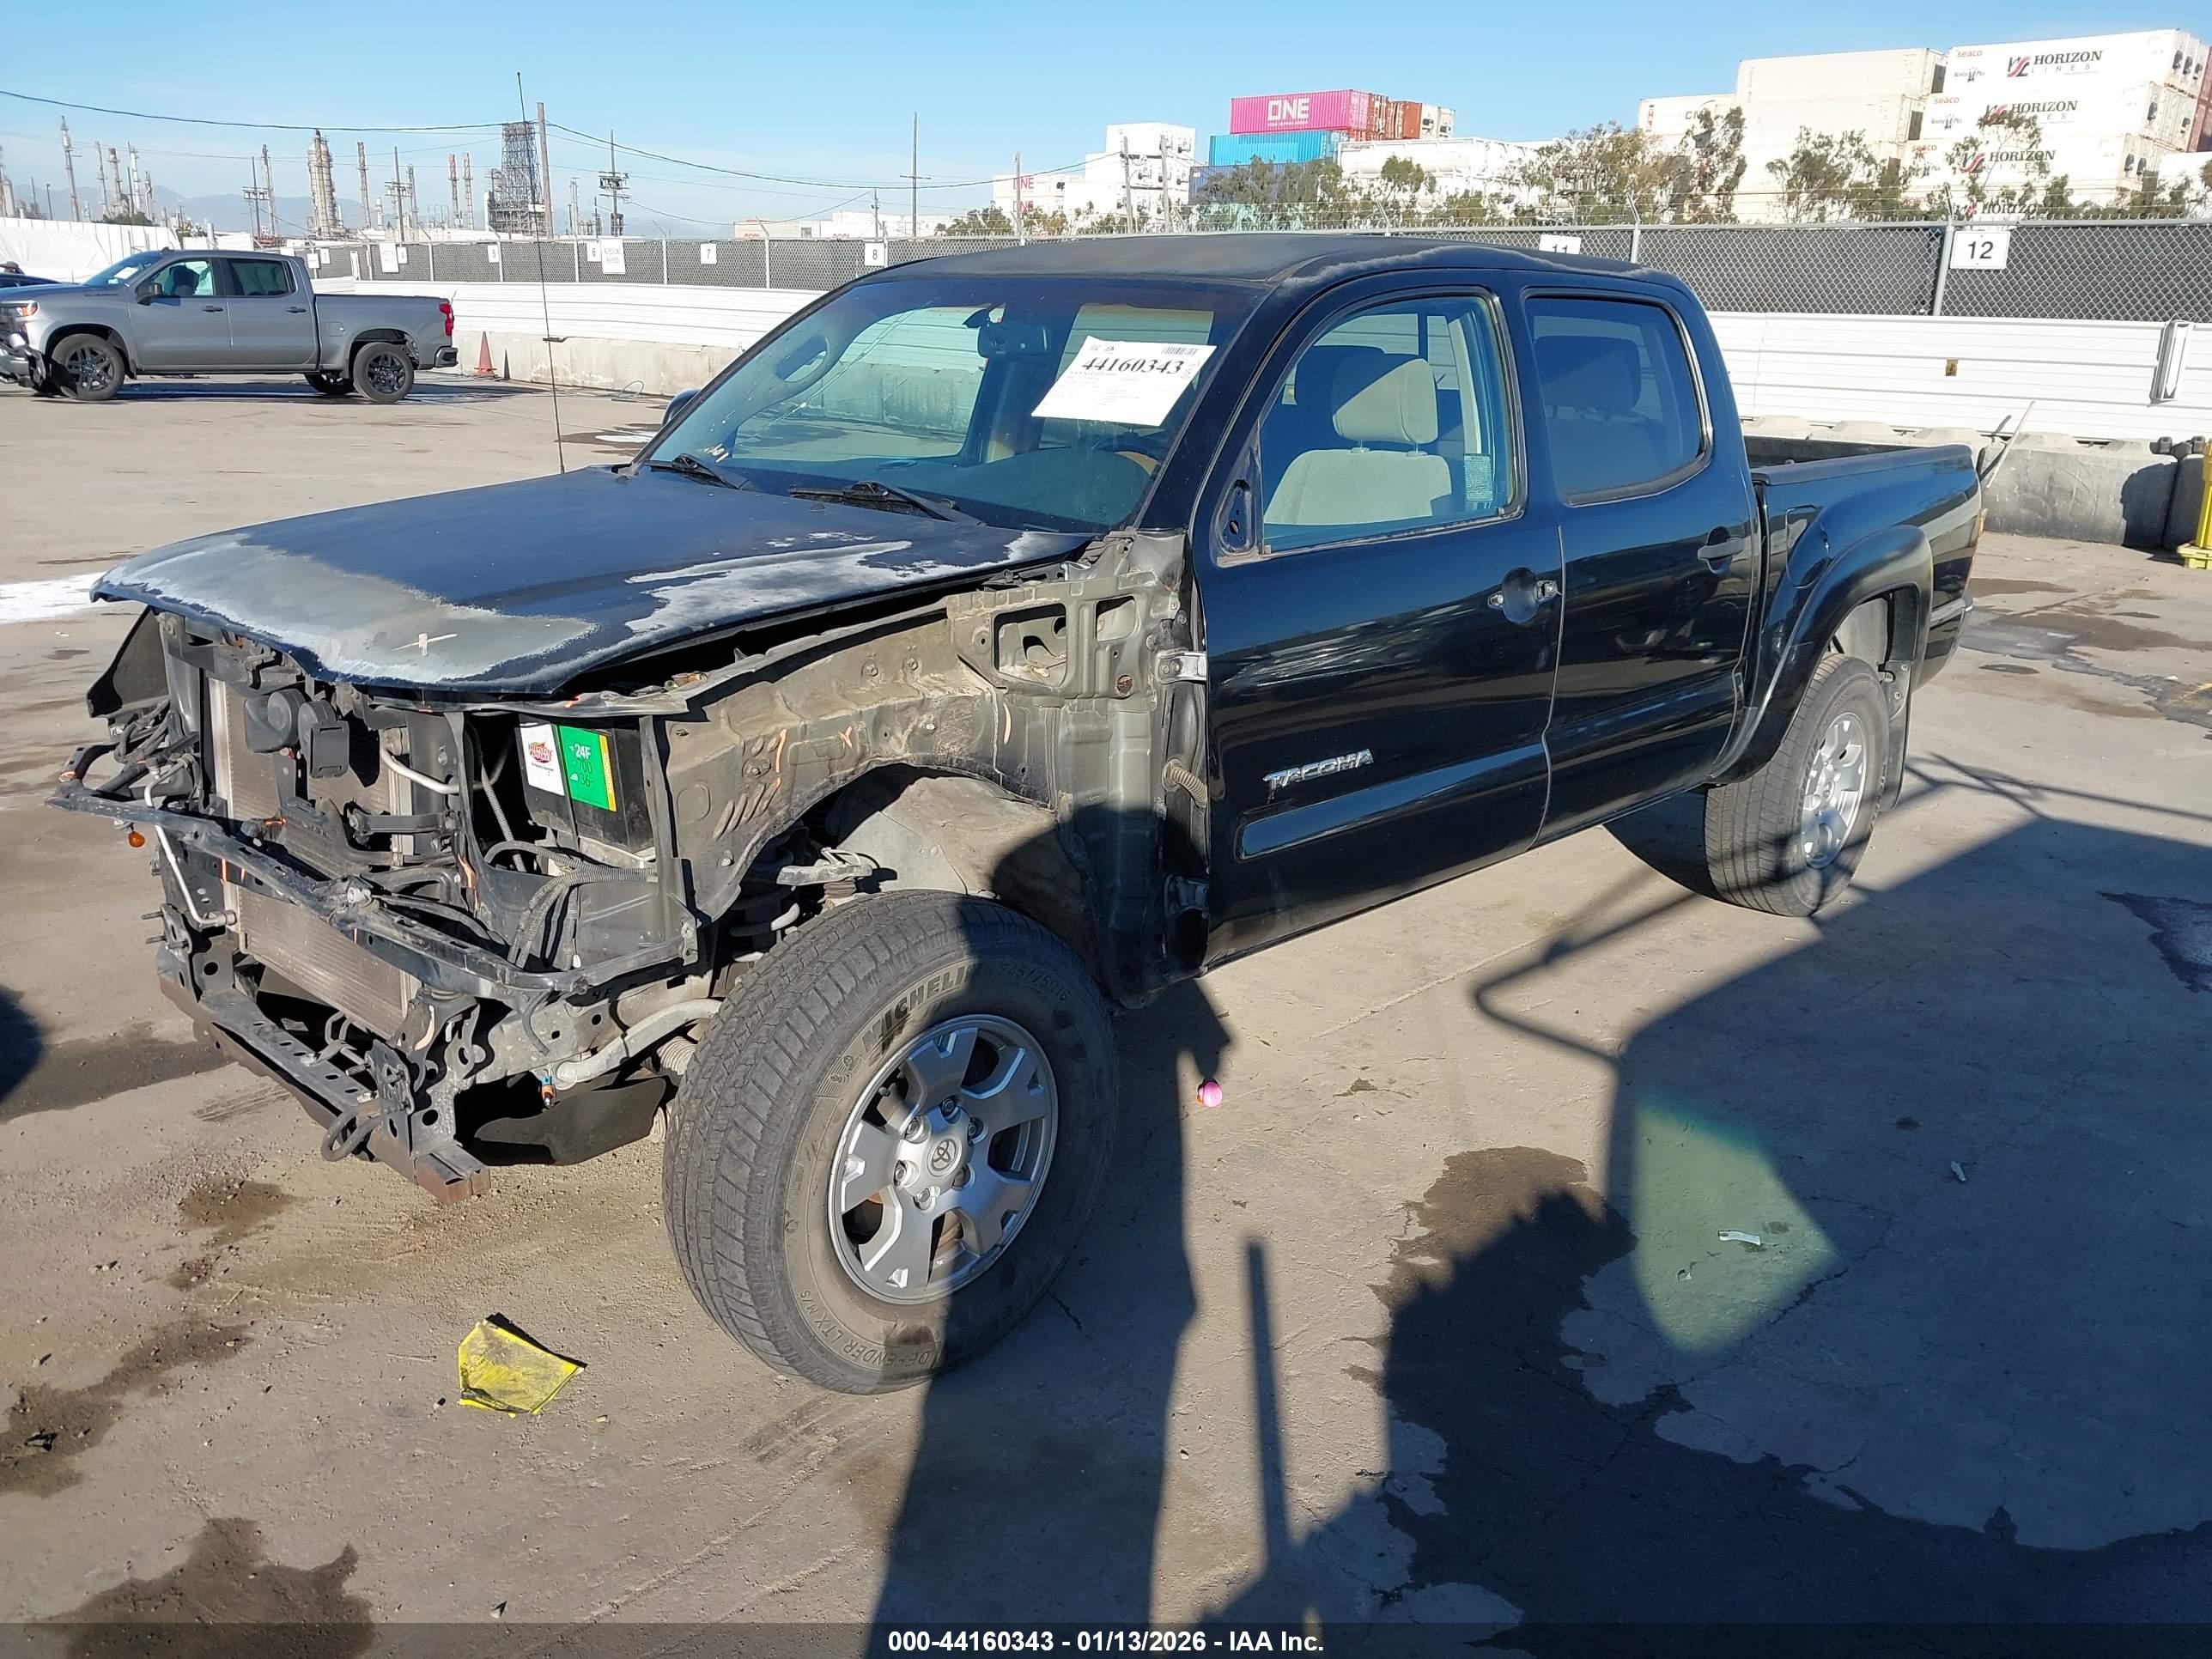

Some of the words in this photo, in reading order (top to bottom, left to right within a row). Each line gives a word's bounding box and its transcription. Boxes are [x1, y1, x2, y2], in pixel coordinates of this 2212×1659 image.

[2033, 50, 2103, 65] HORIZON
[2032, 64, 2091, 74] LINES
[1934, 96, 1960, 105] seaco
[2011, 100, 2078, 113] HORIZON
[1267, 98, 1310, 121] ONE
[1989, 150, 2056, 162] HORIZON
[592, 247, 596, 258] 6
[706, 248, 711, 259] 7
[872, 249, 878, 260] 8
[1968, 240, 1994, 259] 12
[1082, 356, 1185, 374] 44160343
[1262, 748, 1374, 790] TACOMA
[799, 1290, 820, 1316] M/S
[814, 1313, 844, 1345] LTX
